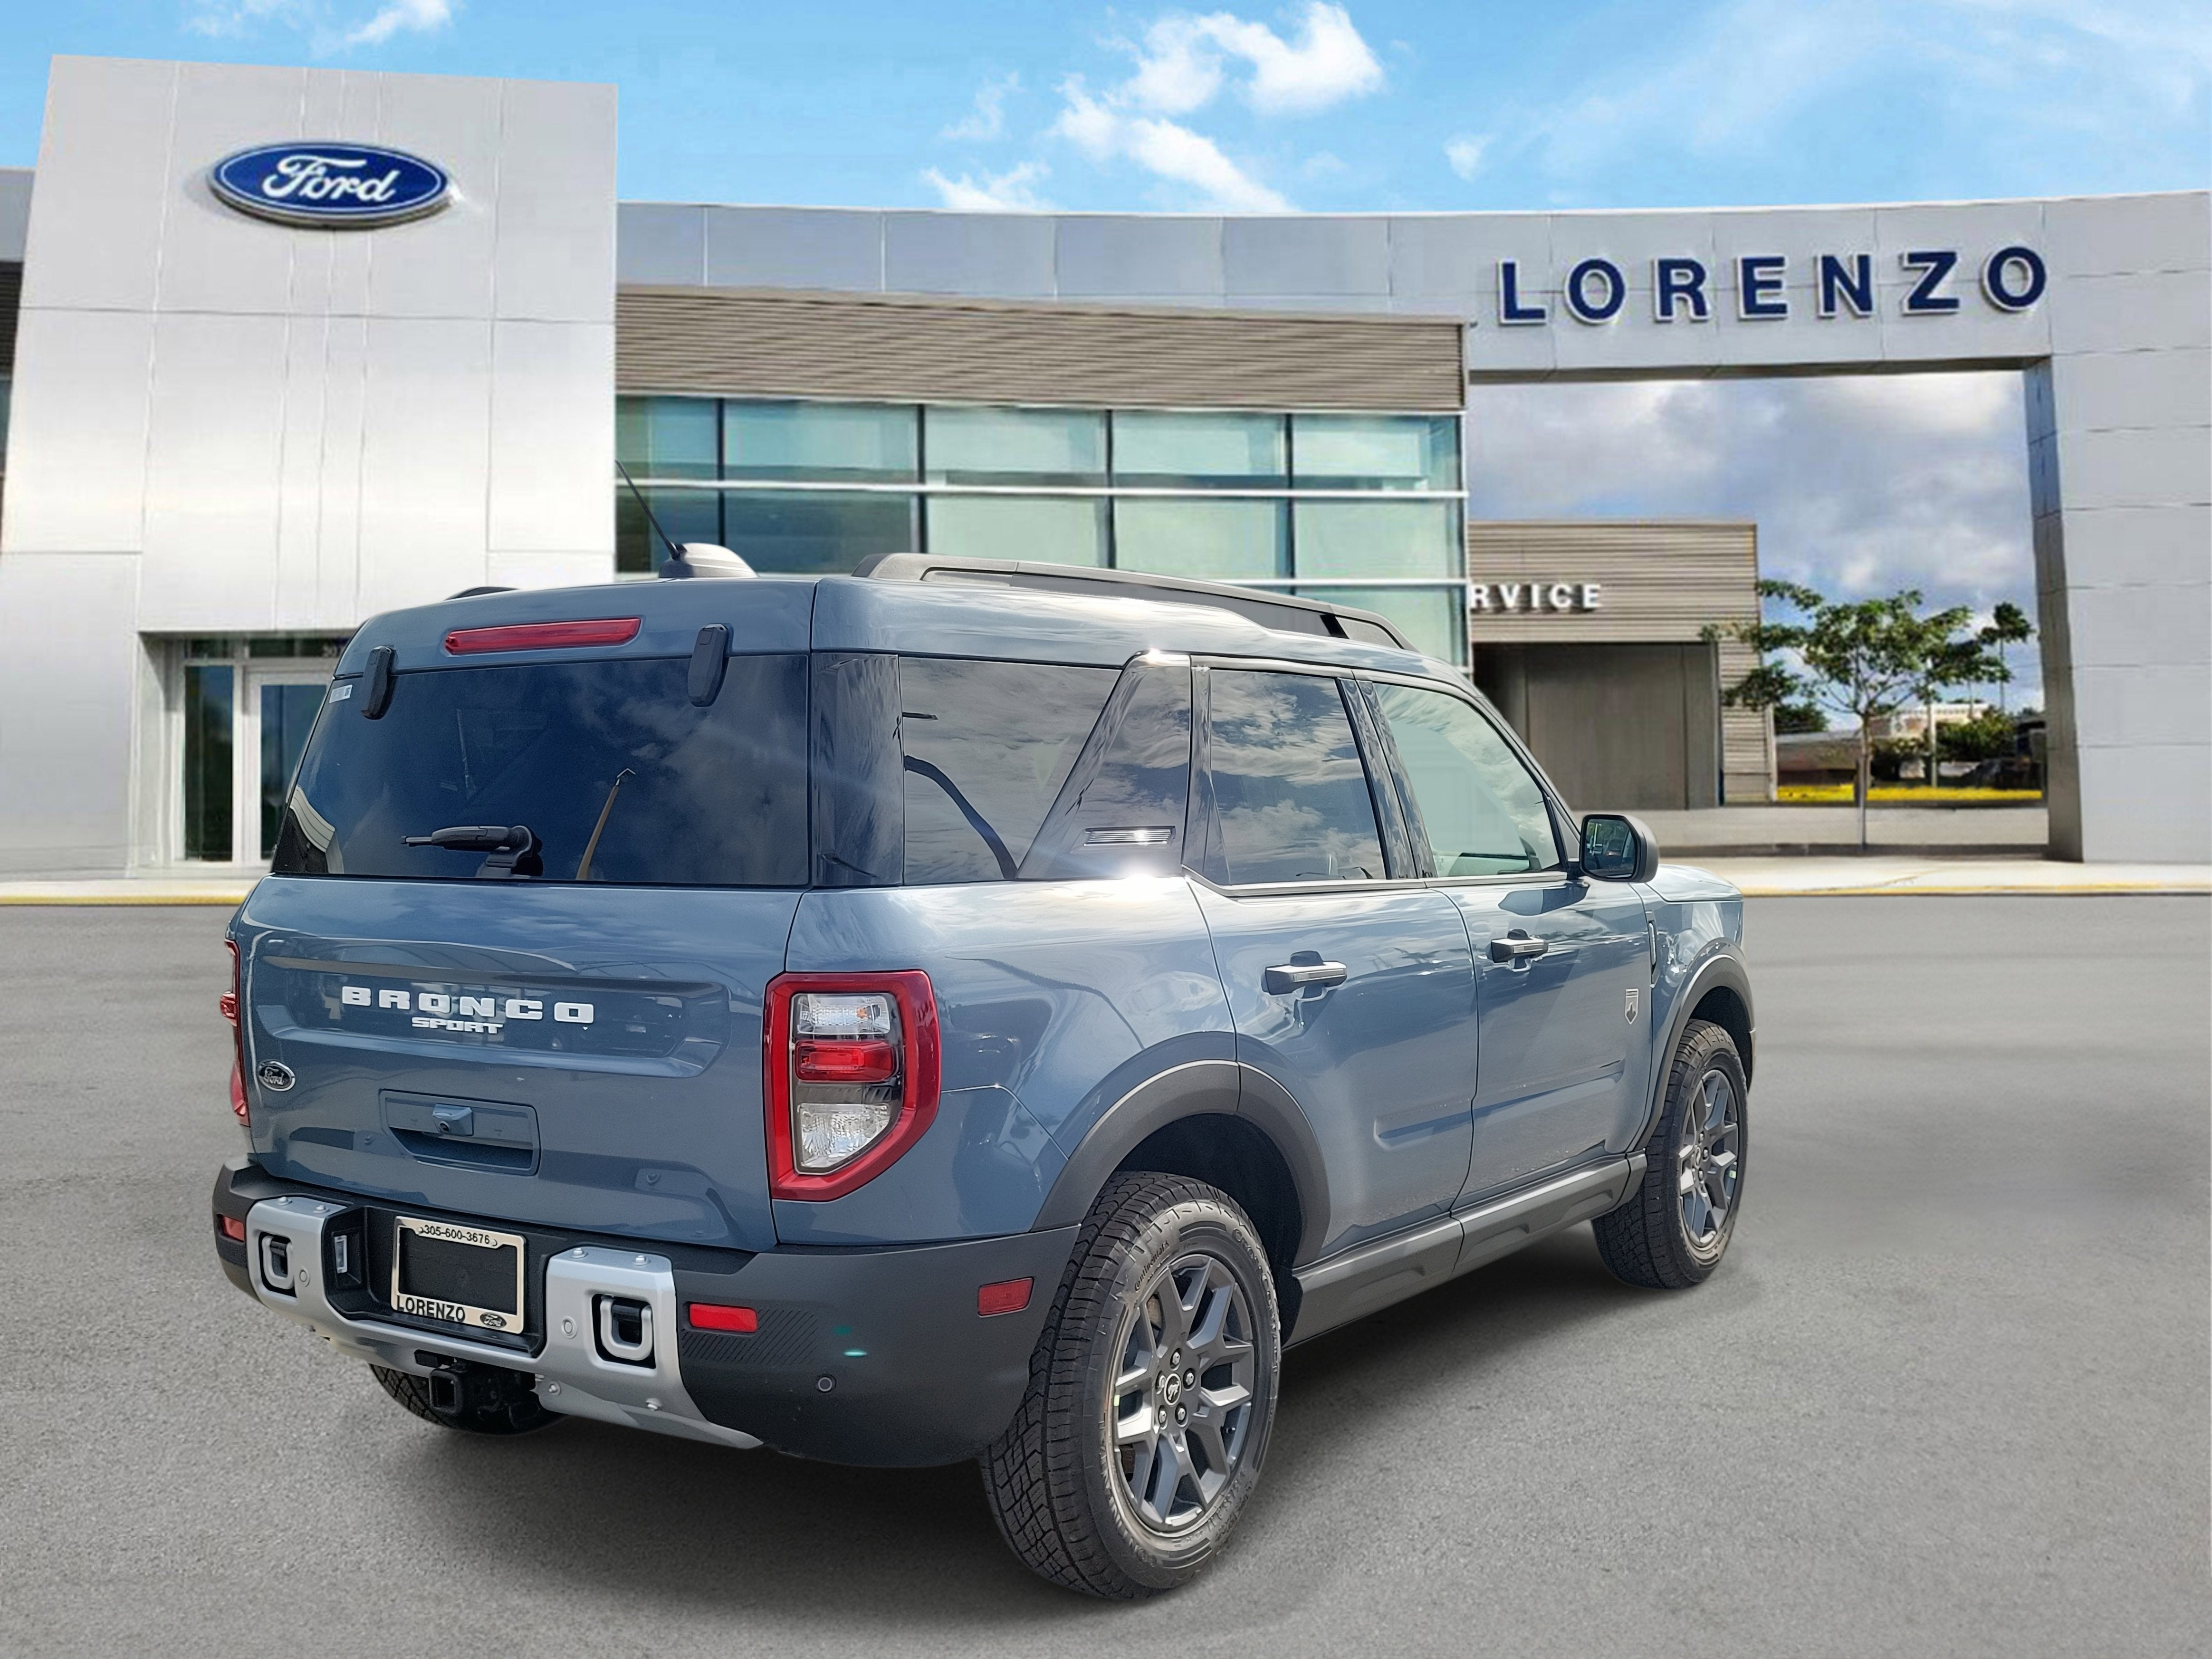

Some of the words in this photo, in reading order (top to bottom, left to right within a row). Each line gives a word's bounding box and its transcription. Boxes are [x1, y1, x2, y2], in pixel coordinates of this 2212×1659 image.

[262, 154, 401, 201] Ford
[1498, 246, 2048, 325] LORENZO
[1471, 584, 1602, 609] RVICE
[342, 986, 594, 1024] BRONCO
[412, 1016, 504, 1034] SPORT
[264, 1066, 284, 1085] Ford
[424, 1224, 490, 1245] 305-600-3676
[397, 1295, 466, 1323] LORENZO
[484, 1314, 503, 1327] Ford
